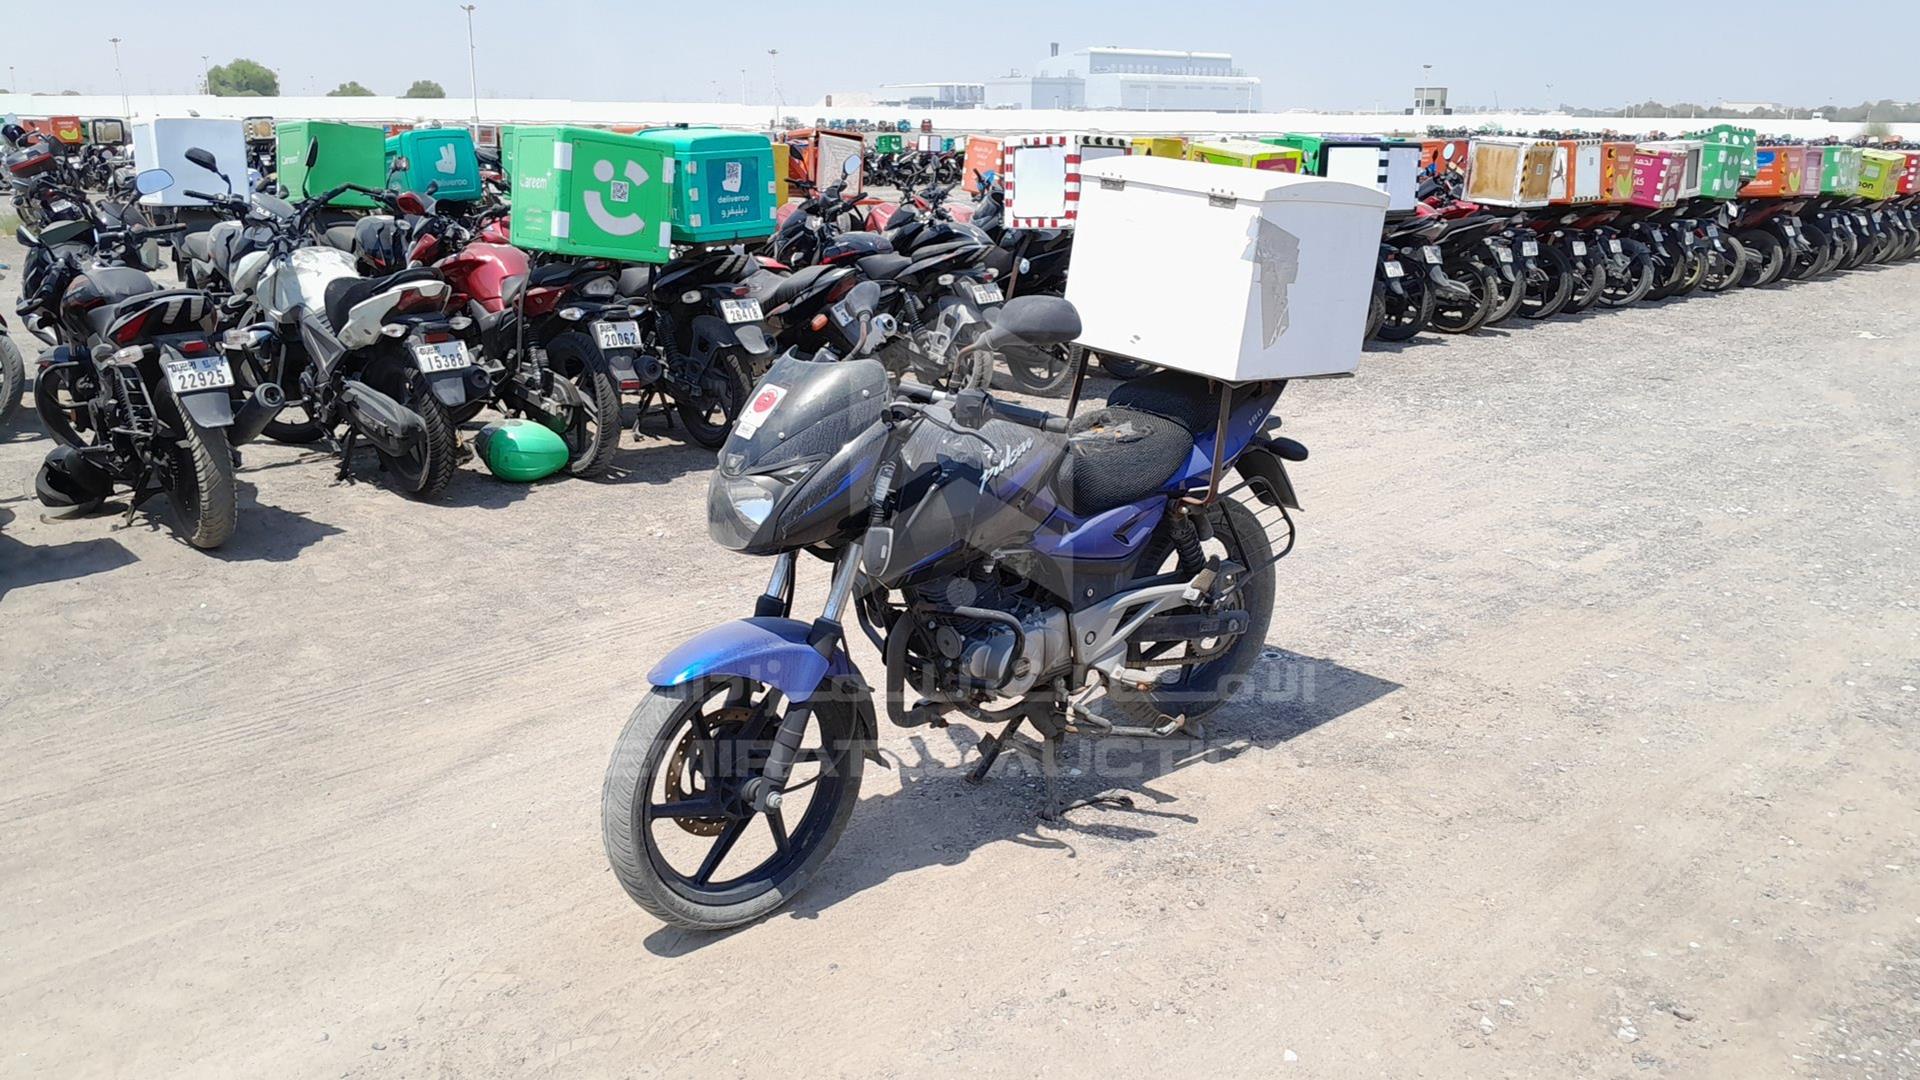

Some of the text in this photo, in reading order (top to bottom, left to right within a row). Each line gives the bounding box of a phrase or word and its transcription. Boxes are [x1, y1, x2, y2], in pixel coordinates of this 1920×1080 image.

[717, 195, 750, 204] deliveroo
[427, 352, 466, 371] 15388
[178, 369, 226, 390] 22925
